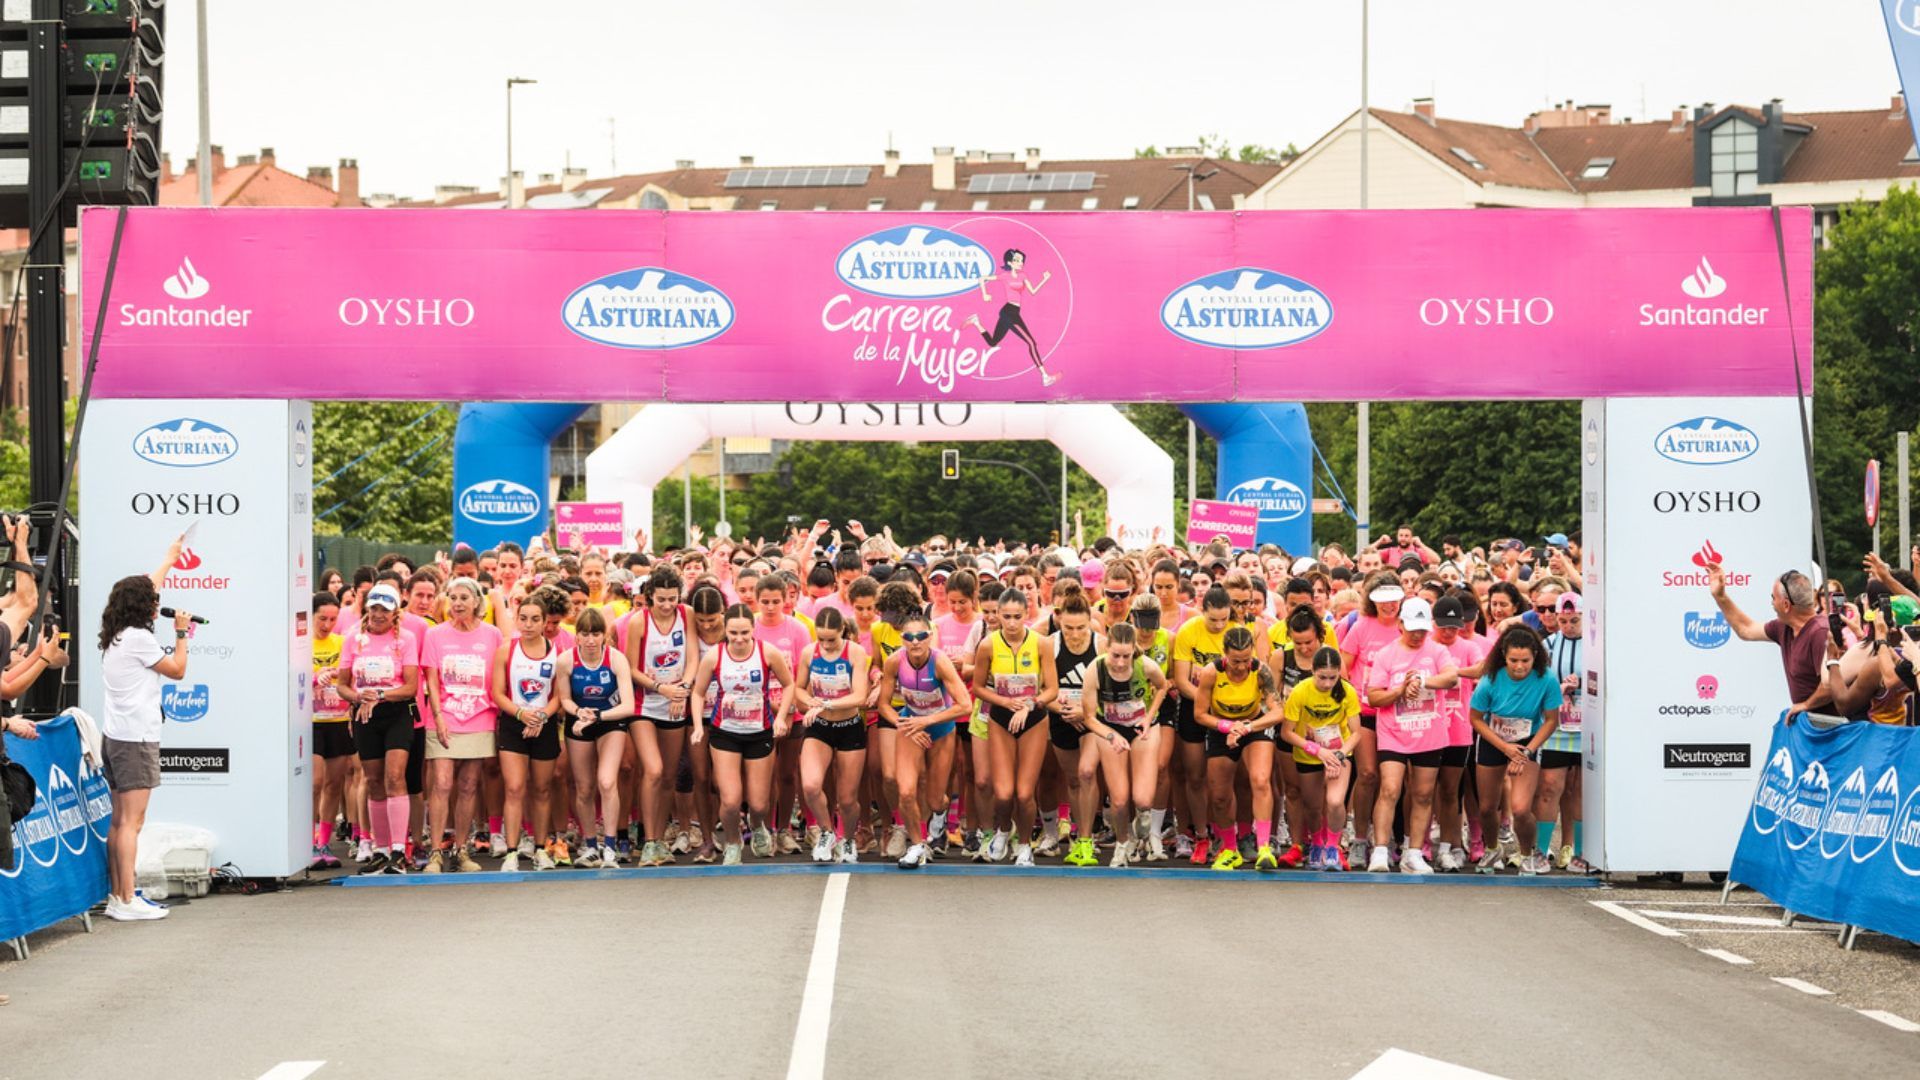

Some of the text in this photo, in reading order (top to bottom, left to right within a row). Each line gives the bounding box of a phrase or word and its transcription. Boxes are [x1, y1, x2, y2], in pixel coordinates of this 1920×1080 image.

[848, 252, 982, 279] ASTURIANA
[120, 303, 252, 328] Santander
[338, 297, 475, 326] OYSHO
[575, 296, 722, 328] ASTURIANA
[822, 294, 951, 332] Carrera
[1174, 297, 1320, 327] ASTURIANA
[1419, 297, 1554, 325] OYSHO
[1639, 303, 1769, 326] Santander
[853, 330, 1001, 393] de la Mujer
[141, 435, 230, 455] ASTURIANA
[1662, 434, 1751, 453] ASTURIANA
[131, 492, 241, 516] OYSHO
[464, 497, 536, 514] ASTURIANA
[1653, 490, 1761, 513] OYSHO
[1190, 519, 1255, 535] CORREDORAS
[161, 574, 230, 590] ntander
[1662, 570, 1751, 587] Santader
[1686, 619, 1728, 641] Marlene
[190, 644, 234, 660] energy
[164, 692, 206, 712] Marlene
[1658, 704, 1757, 719] octopus energy
[159, 755, 224, 771] eutrogena
[1669, 748, 1747, 766] Neutrogena
